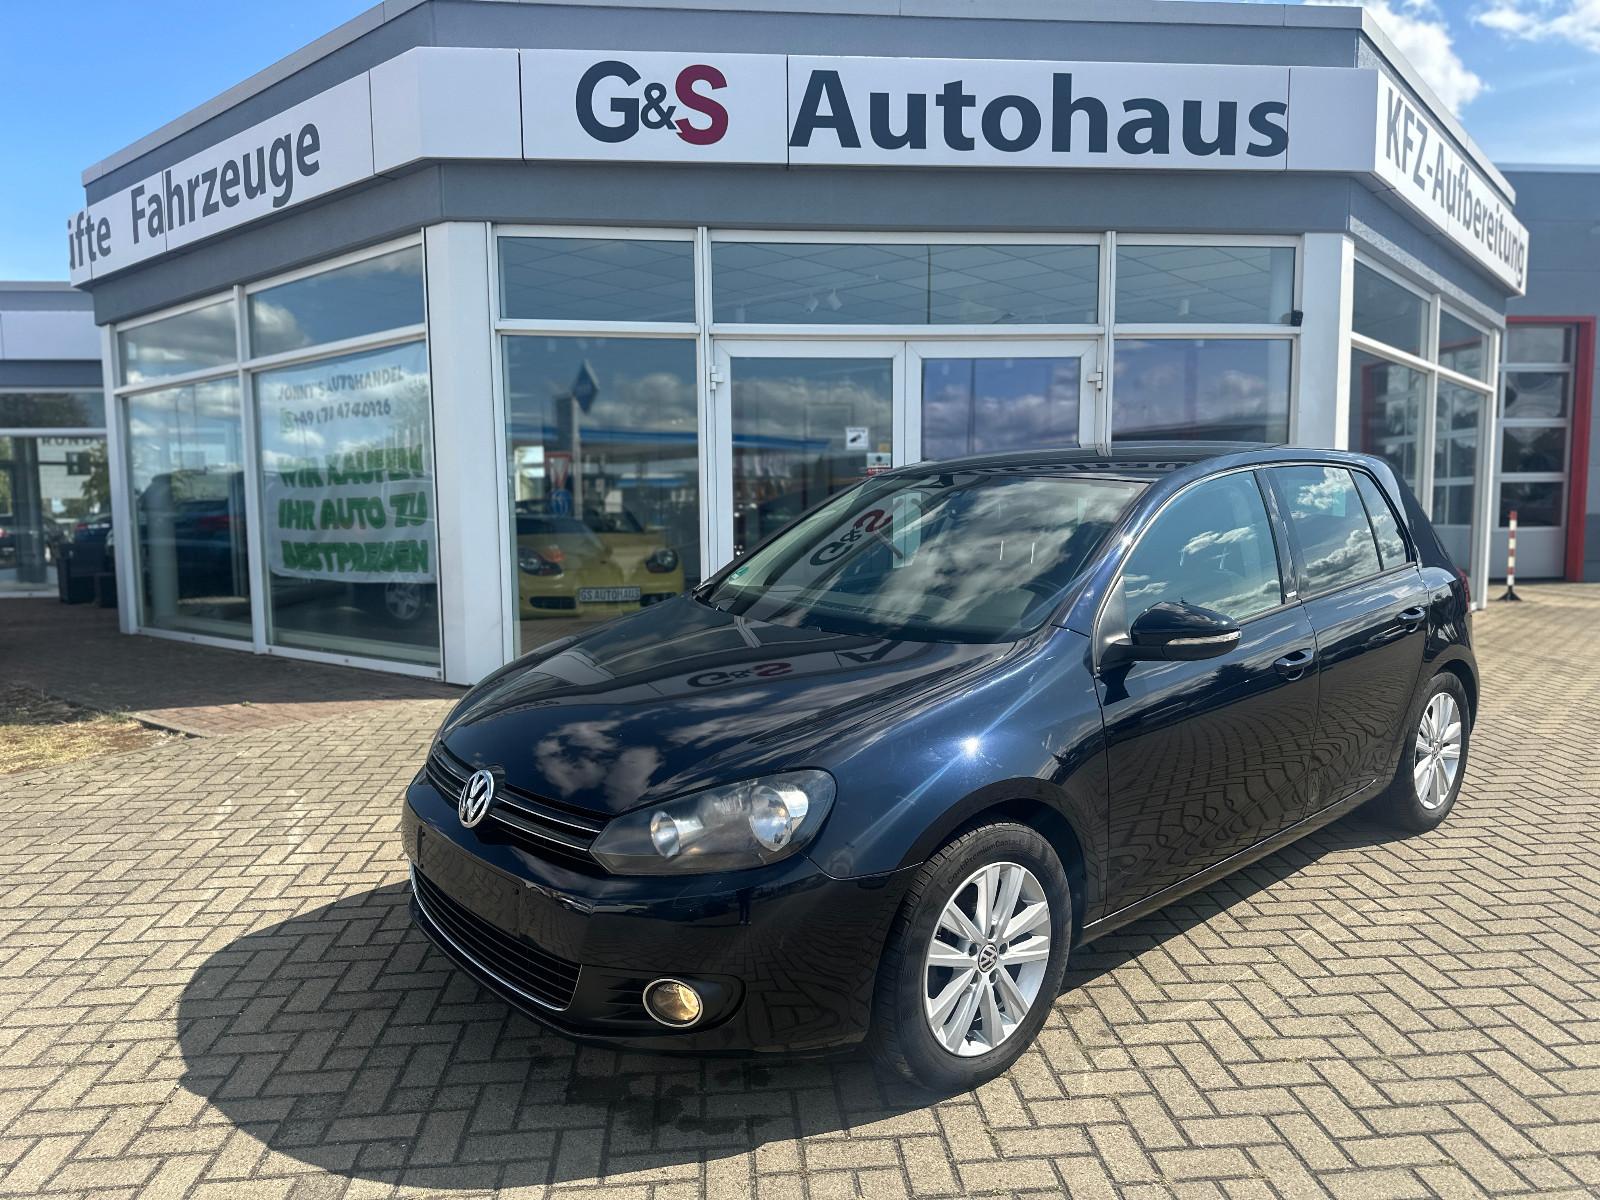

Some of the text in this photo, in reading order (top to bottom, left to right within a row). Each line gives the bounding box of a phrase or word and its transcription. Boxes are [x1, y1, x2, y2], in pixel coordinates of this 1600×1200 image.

[575, 60, 1290, 157] G&S Autohaus
[130, 123, 321, 245] Fahrzeuge
[1385, 86, 1526, 289] KFZ-Aufbereitung
[278, 491, 428, 530] IHR AUTO ZU
[595, 588, 640, 600] AUTOHAUS
